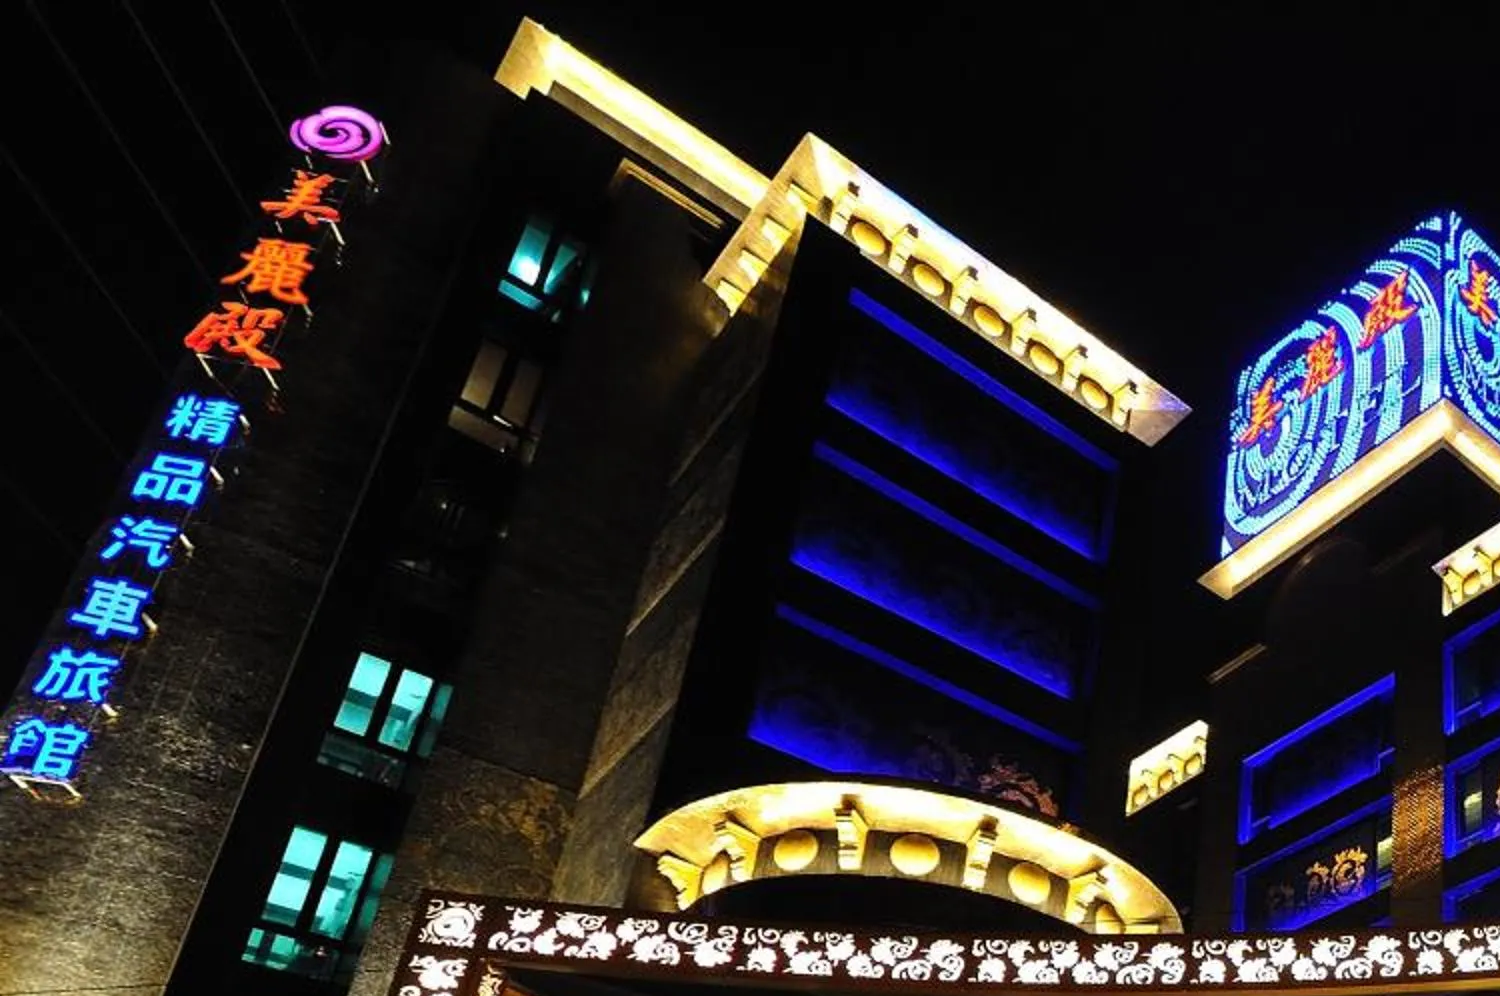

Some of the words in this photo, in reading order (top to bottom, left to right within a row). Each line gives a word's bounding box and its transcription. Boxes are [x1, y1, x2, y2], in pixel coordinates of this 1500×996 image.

[183, 169, 341, 370] 美麗殿
[1237, 269, 1420, 448] 美麗殿
[8, 394, 241, 778] 精品汽車旅館
